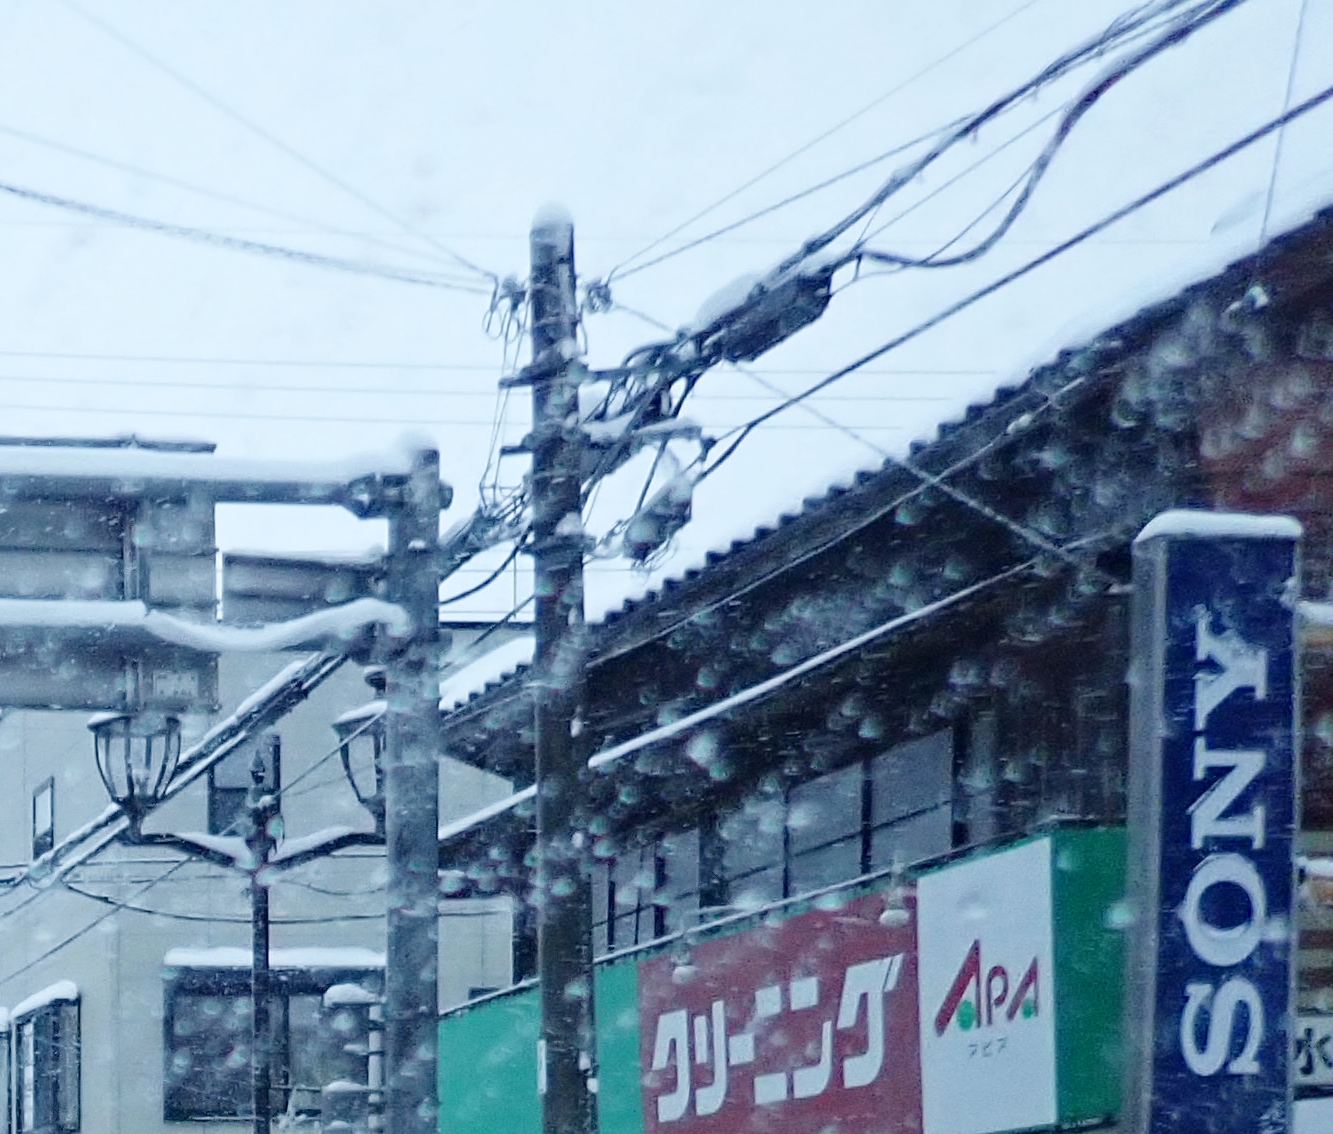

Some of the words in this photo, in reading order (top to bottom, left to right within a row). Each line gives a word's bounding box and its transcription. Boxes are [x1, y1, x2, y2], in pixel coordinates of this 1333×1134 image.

[1180, 603, 1268, 1077] SONY
[650, 953, 905, 1123] クリーニング
